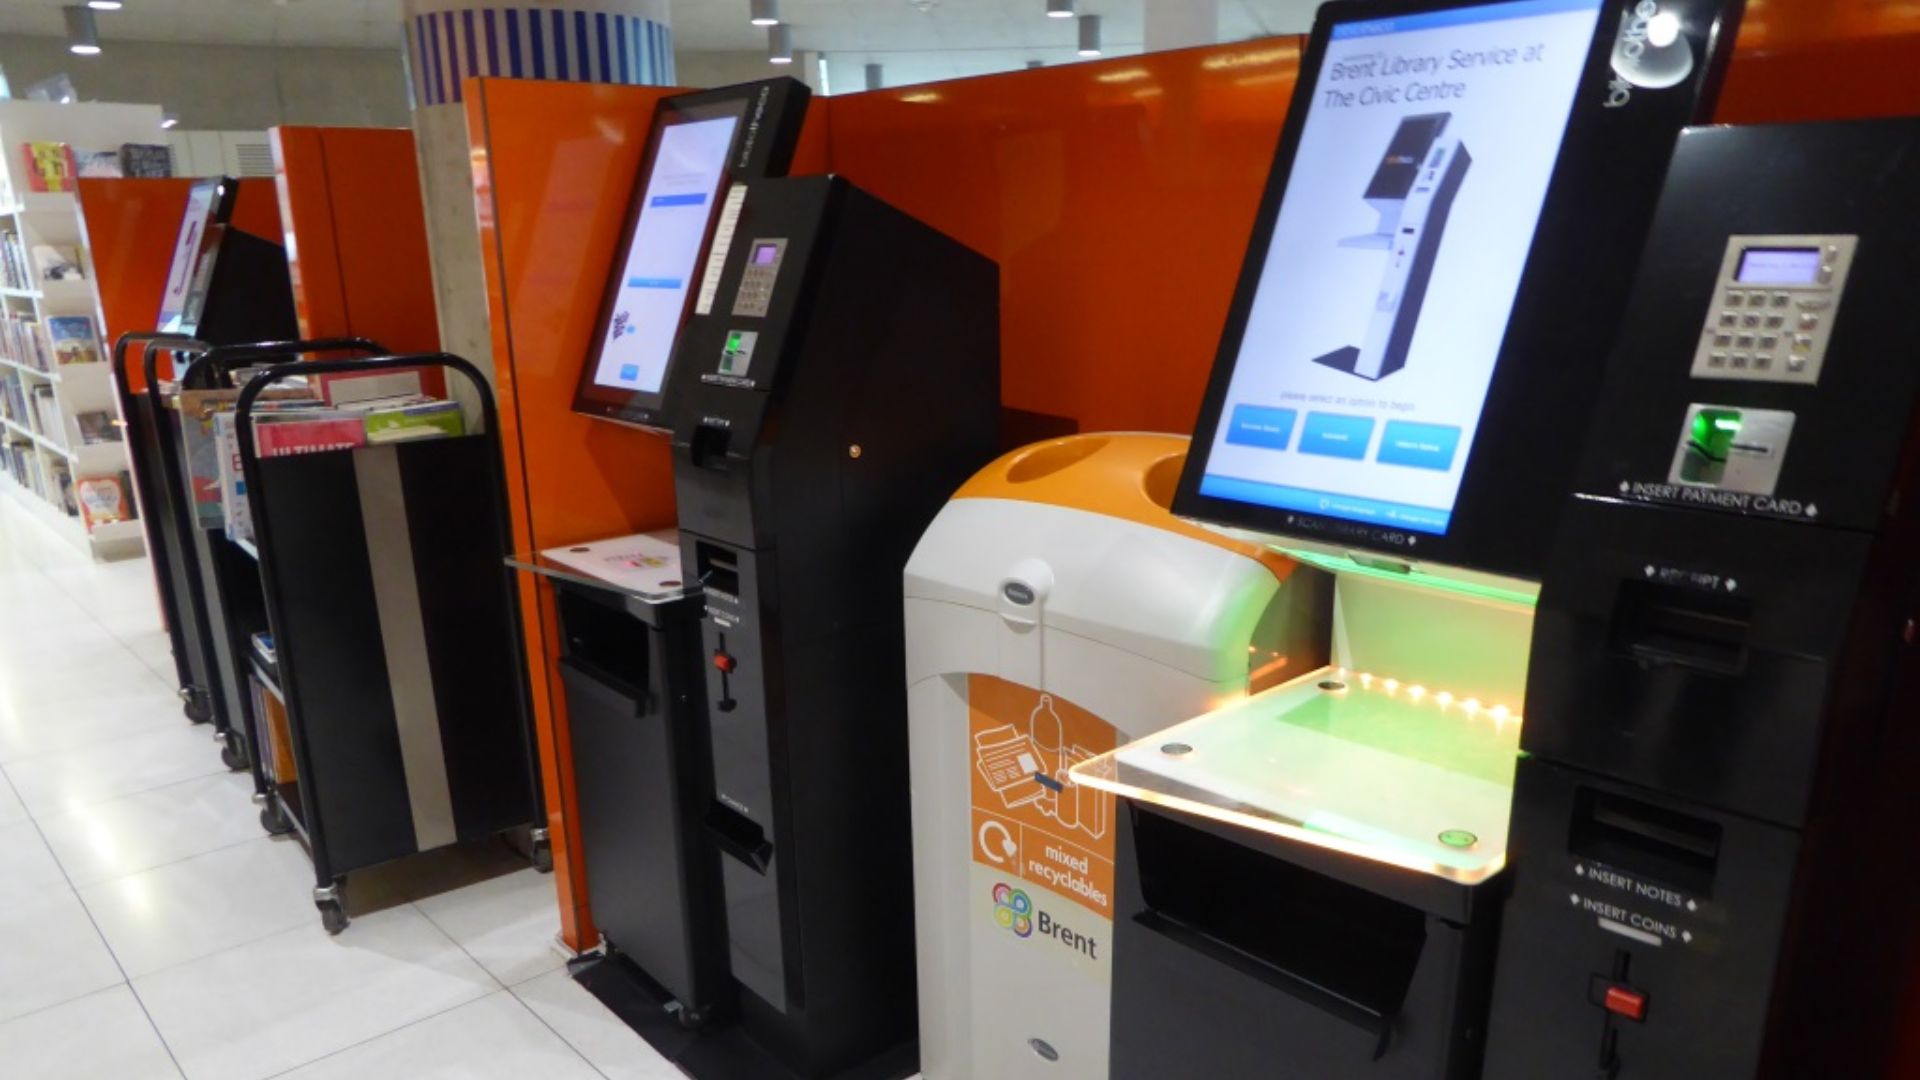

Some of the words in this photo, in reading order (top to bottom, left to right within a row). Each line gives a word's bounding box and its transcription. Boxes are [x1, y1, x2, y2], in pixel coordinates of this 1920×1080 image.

[1330, 60, 1377, 82] Brent
[1380, 55, 1441, 76] Library
[1447, 47, 1518, 70] Service
[1522, 44, 1545, 63] at
[1324, 89, 1354, 109] The
[1358, 84, 1401, 106] Civic
[1404, 80, 1466, 103] Centre
[1632, 481, 1680, 500] INSERT
[1682, 485, 1752, 508] PAYMENT
[1753, 497, 1803, 515] CARD
[1045, 843, 1089, 875] mixed
[1029, 861, 1108, 907] recyclables
[1588, 866, 1634, 892] INSERT
[1635, 880, 1682, 907] NOTES
[1038, 910, 1098, 960] Brent
[1583, 897, 1627, 922] INSERT
[1630, 912, 1677, 939] COINS
